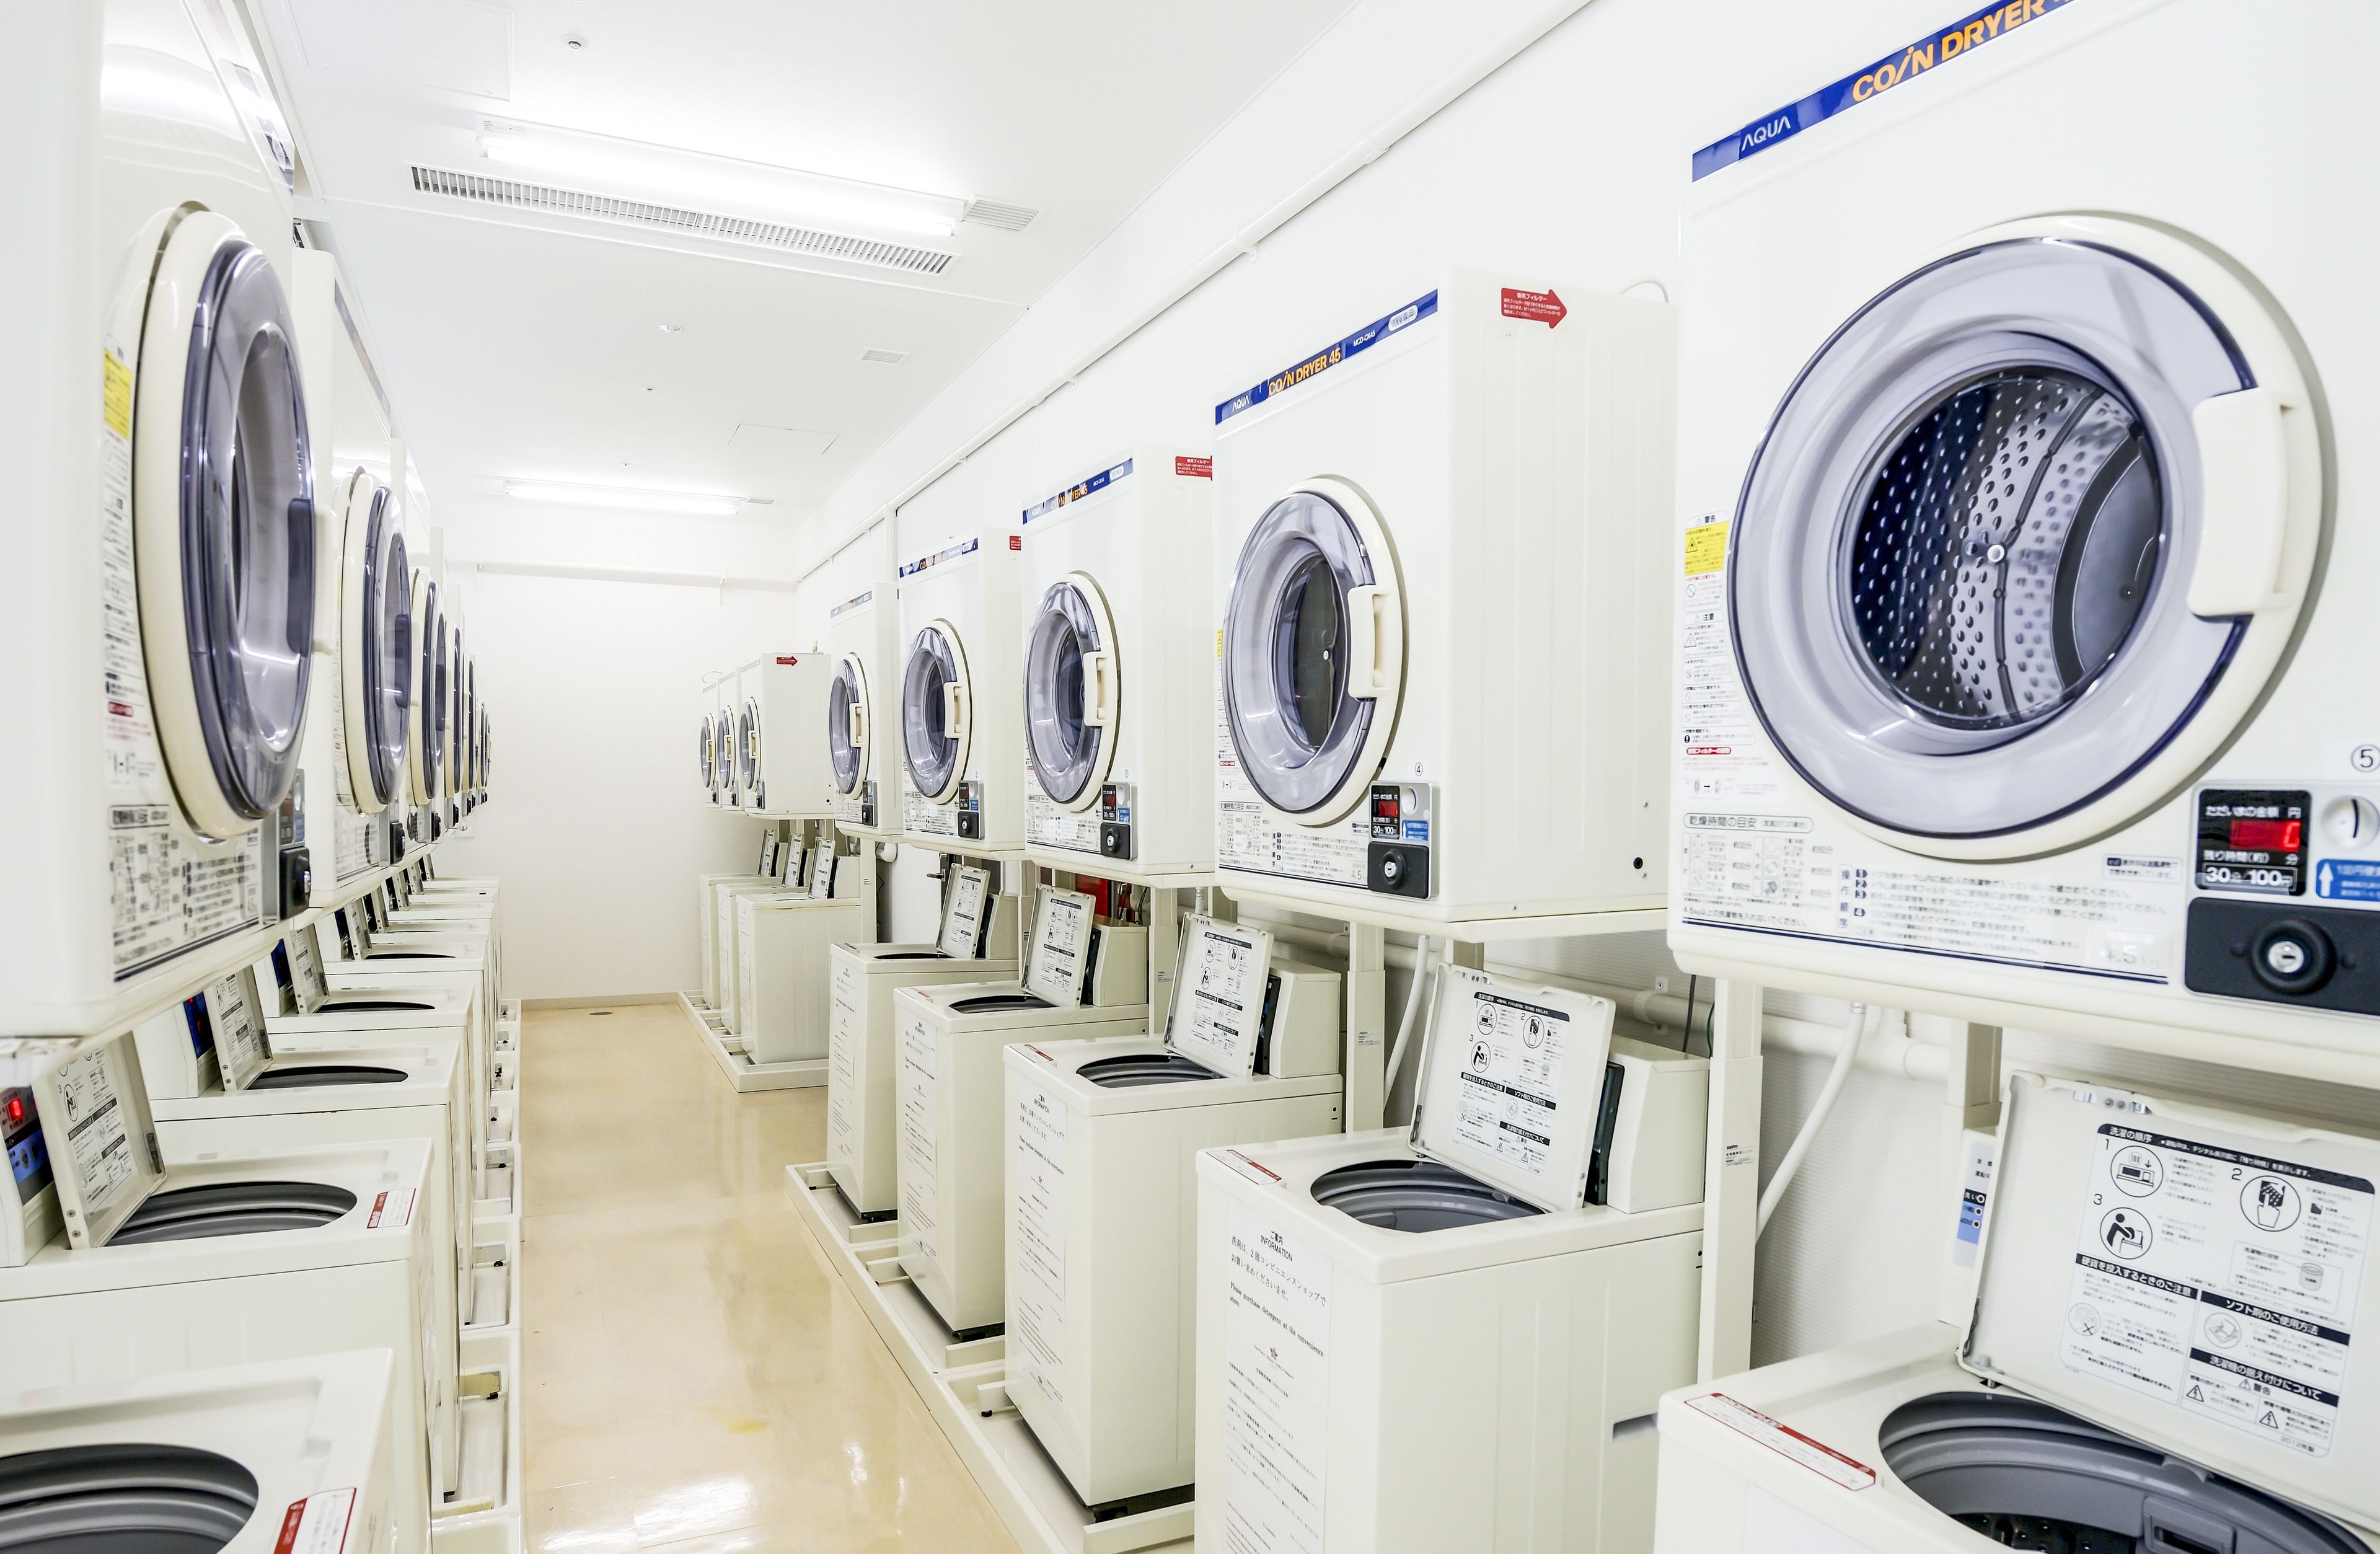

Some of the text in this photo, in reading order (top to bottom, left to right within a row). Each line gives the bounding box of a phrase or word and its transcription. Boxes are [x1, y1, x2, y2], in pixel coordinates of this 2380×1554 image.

[1853, 46, 1934, 102] COIN
[1742, 116, 1791, 151] AQUA
[1269, 347, 1341, 396] COIN DRYER 45
[1232, 395, 1250, 412] AQUA
[2288, 806, 2302, 818] 円
[1690, 816, 1756, 828] 乾燥時間の目安
[2285, 854, 2299, 865] 分
[2109, 1126, 2153, 1143] 洗濯の順序
[2105, 1139, 2109, 1150] 1
[2232, 1168, 2242, 1180] 2
[2094, 1193, 2102, 1205] 3
[1271, 1231, 1283, 1245] ご案内
[1261, 1235, 1293, 1262] INFORMATION
[2081, 1256, 2192, 1297] 硬貨を投入するときのご注意
[1230, 1281, 1242, 1296] Please
[1243, 1292, 1261, 1310] purchase
[1262, 1306, 1282, 1326] detergent
[1297, 1333, 1324, 1357] convenience
[2226, 1300, 2319, 1335] ソフト剤のご使用方法
[2210, 1355, 2322, 1401] 洗濯機の据え付けについて
